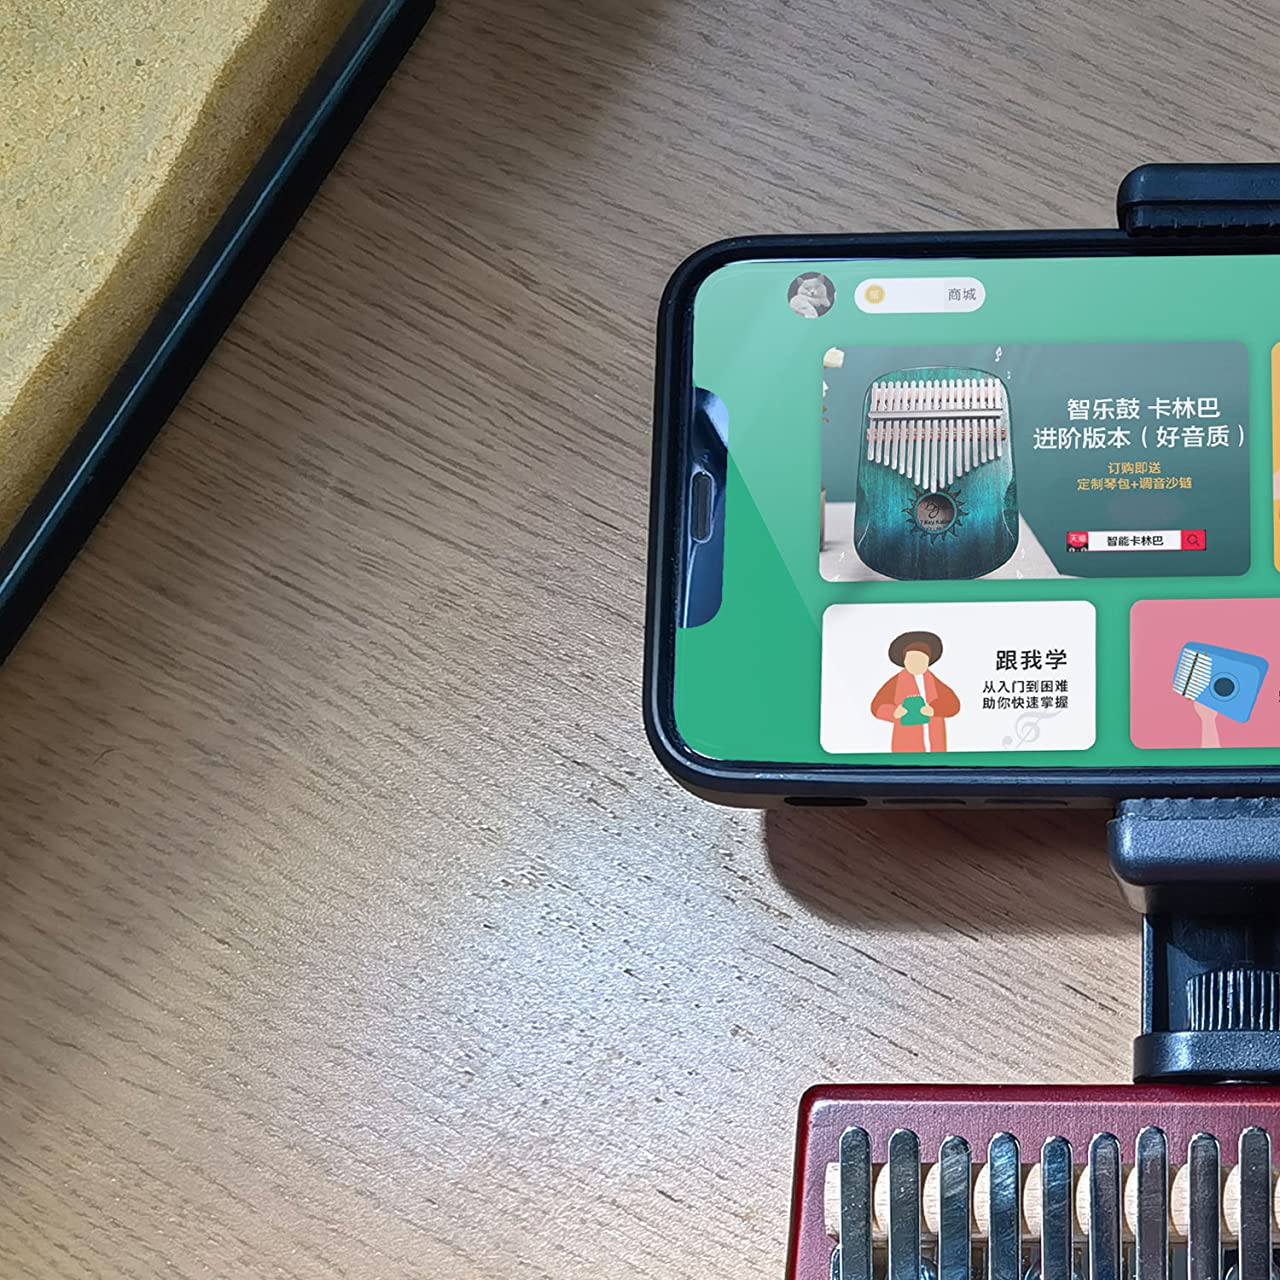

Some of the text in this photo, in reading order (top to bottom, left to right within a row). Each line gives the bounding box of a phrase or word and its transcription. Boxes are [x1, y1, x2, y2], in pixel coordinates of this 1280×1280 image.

[947, 287, 977, 302] 商城
[1067, 396, 1221, 421] 智乐鼓 卡林巴
[1107, 461, 1162, 475] 订购即送
[1106, 535, 1164, 547] 智能卡林巴
[995, 648, 1068, 672] 跟我学
[982, 678, 1069, 695] 从入门到困难
[982, 695, 1069, 711] 助你快速掌握
